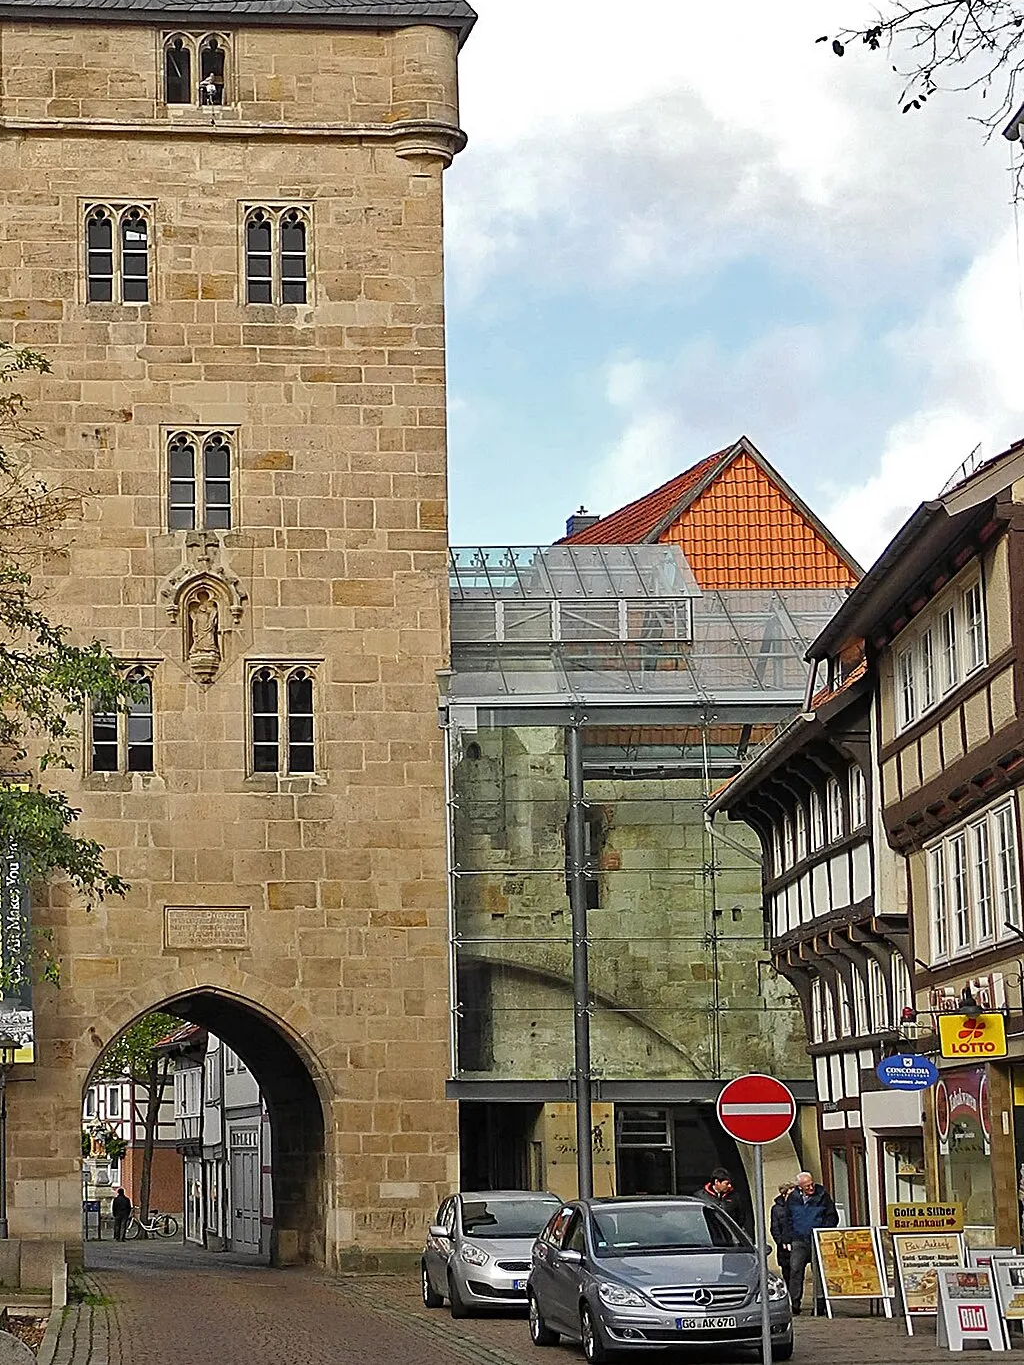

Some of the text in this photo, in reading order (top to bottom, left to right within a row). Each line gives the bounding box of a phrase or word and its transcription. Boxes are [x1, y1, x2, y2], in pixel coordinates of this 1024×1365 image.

[5, 862, 20, 886] You
[952, 1042, 996, 1053] LOTTO
[893, 1207, 956, 1217] Gold & Silber
[894, 1219, 945, 1228] Bar-Ankauf
[682, 1317, 735, 1328] GÖ AK 670
[960, 1307, 985, 1328] Bild
